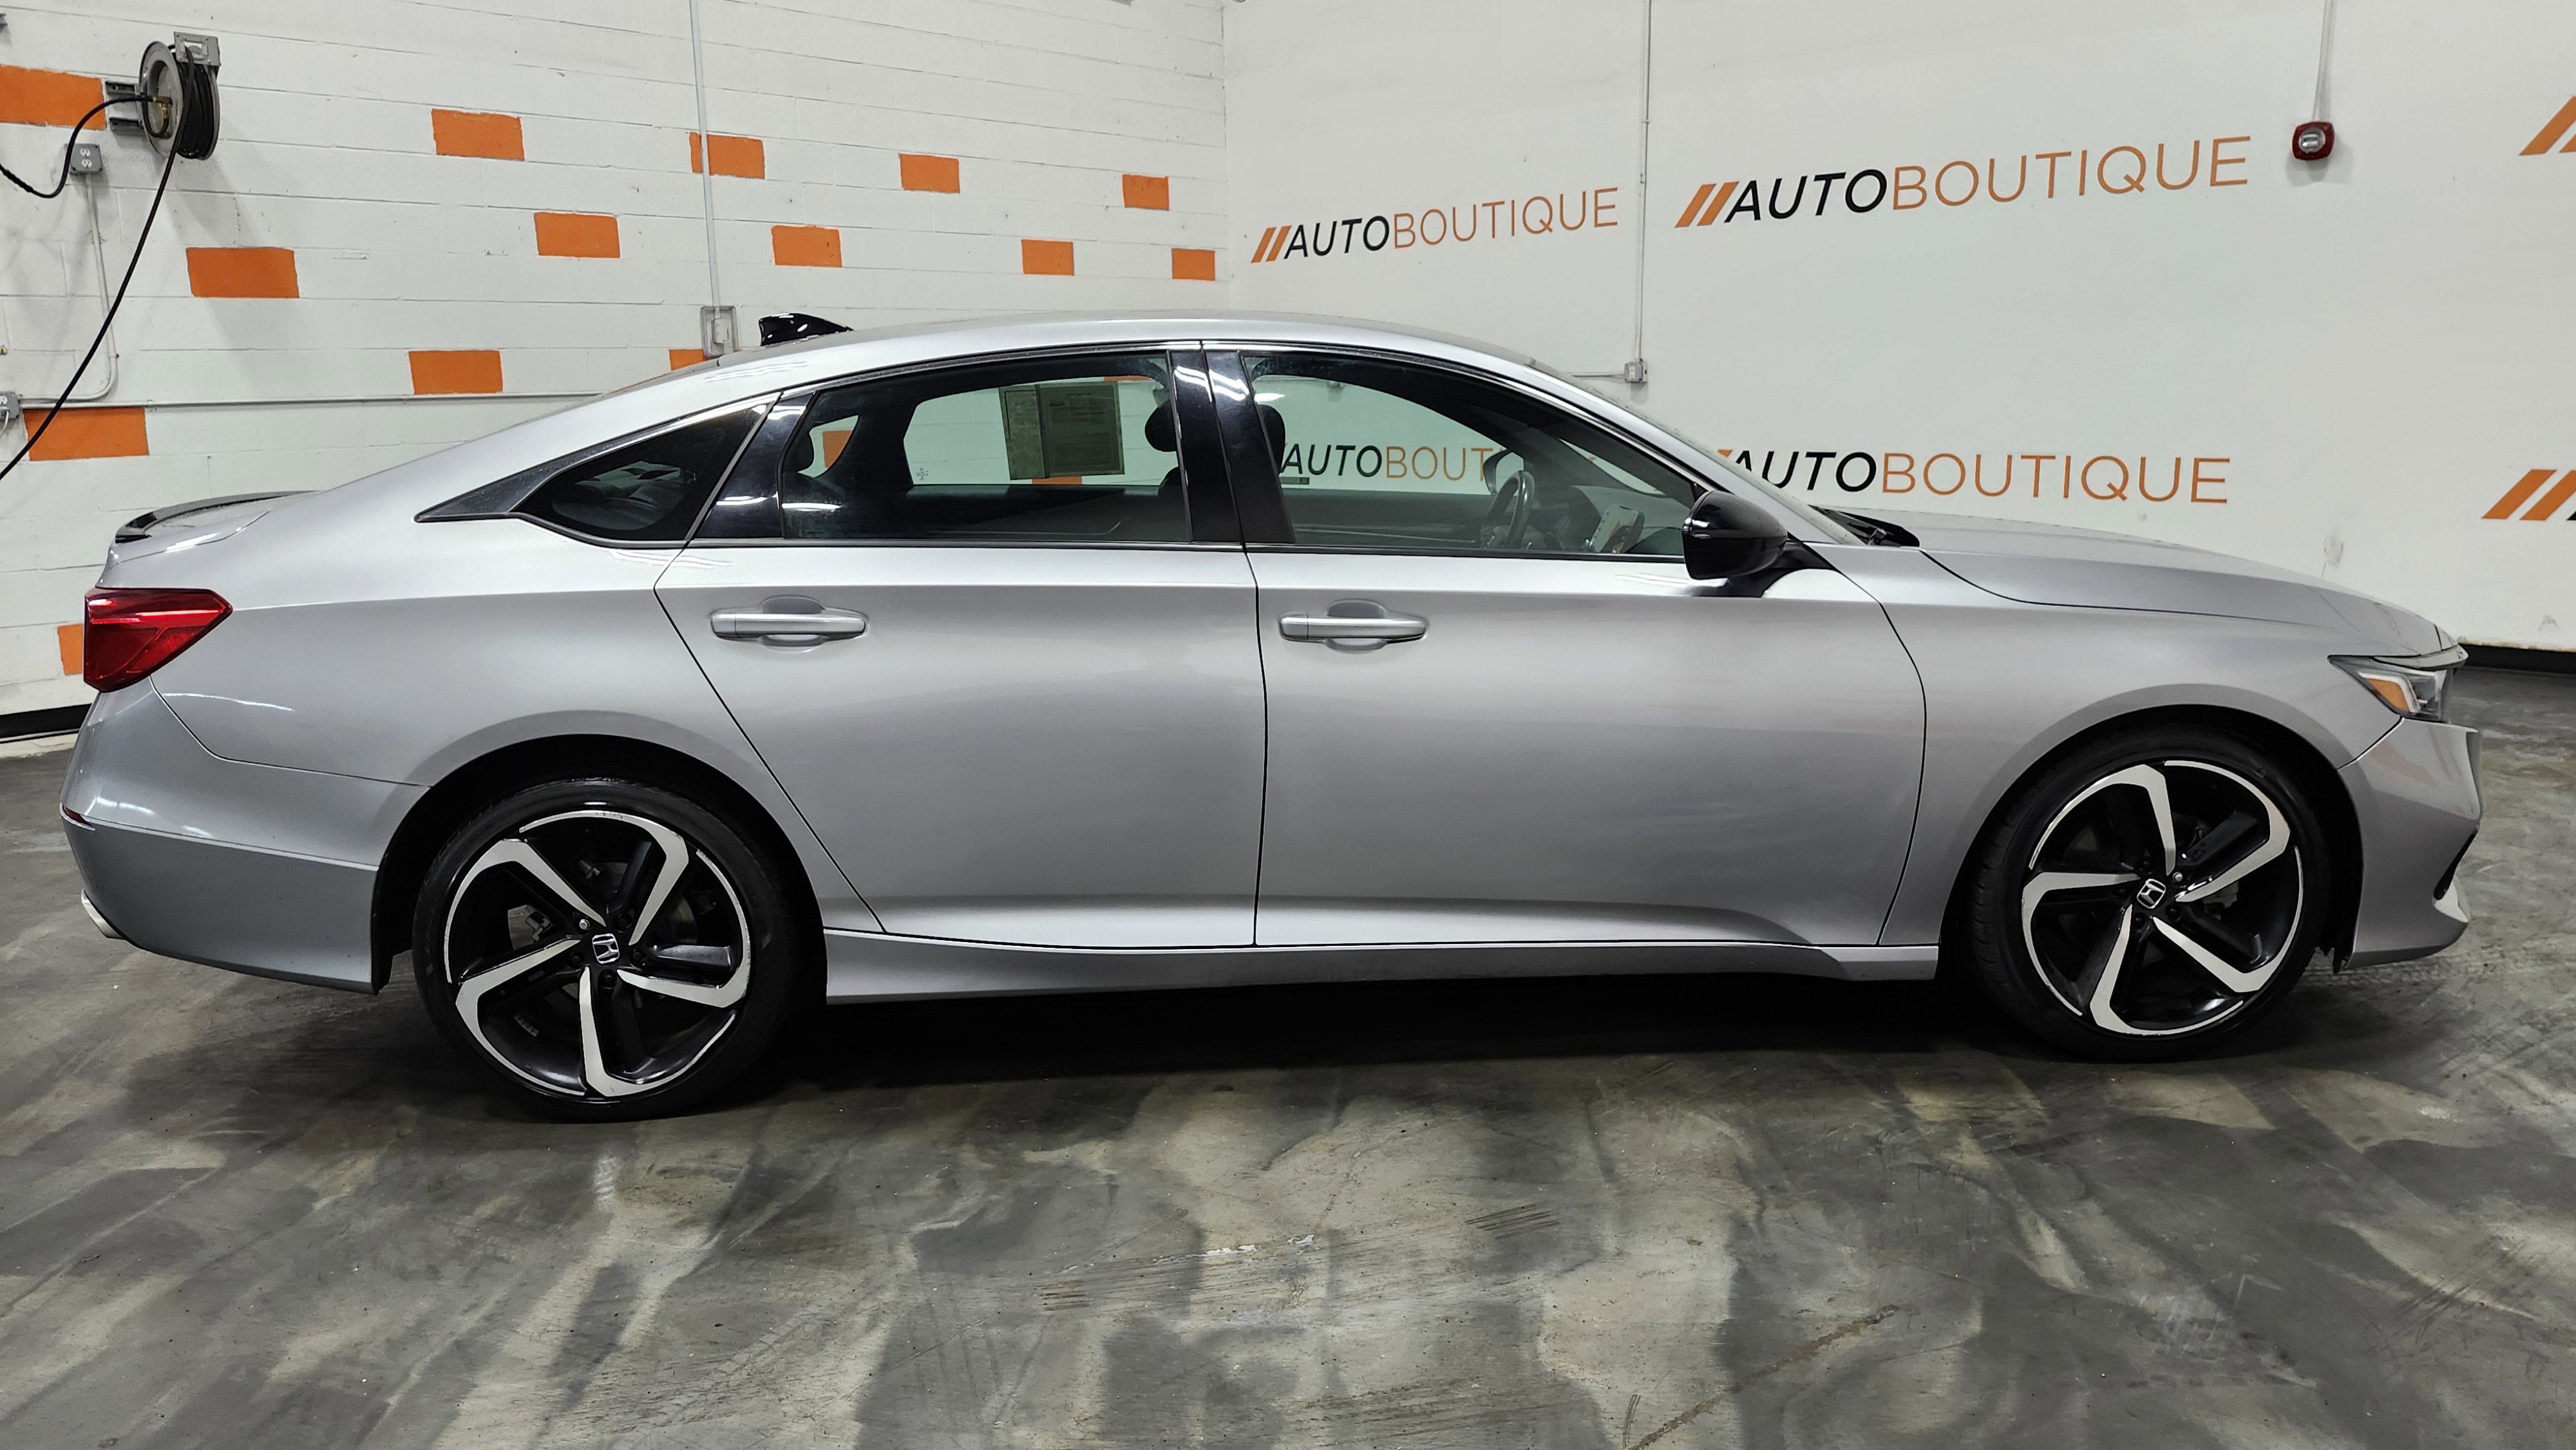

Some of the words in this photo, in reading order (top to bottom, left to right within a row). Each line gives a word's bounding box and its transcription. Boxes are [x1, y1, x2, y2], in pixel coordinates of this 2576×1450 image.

[1723, 136, 2251, 223] AUTOBOUTIQUE
[1283, 187, 1619, 259] AUTOBOUTIQUE
[1280, 444, 1493, 482] AUTOBOUT
